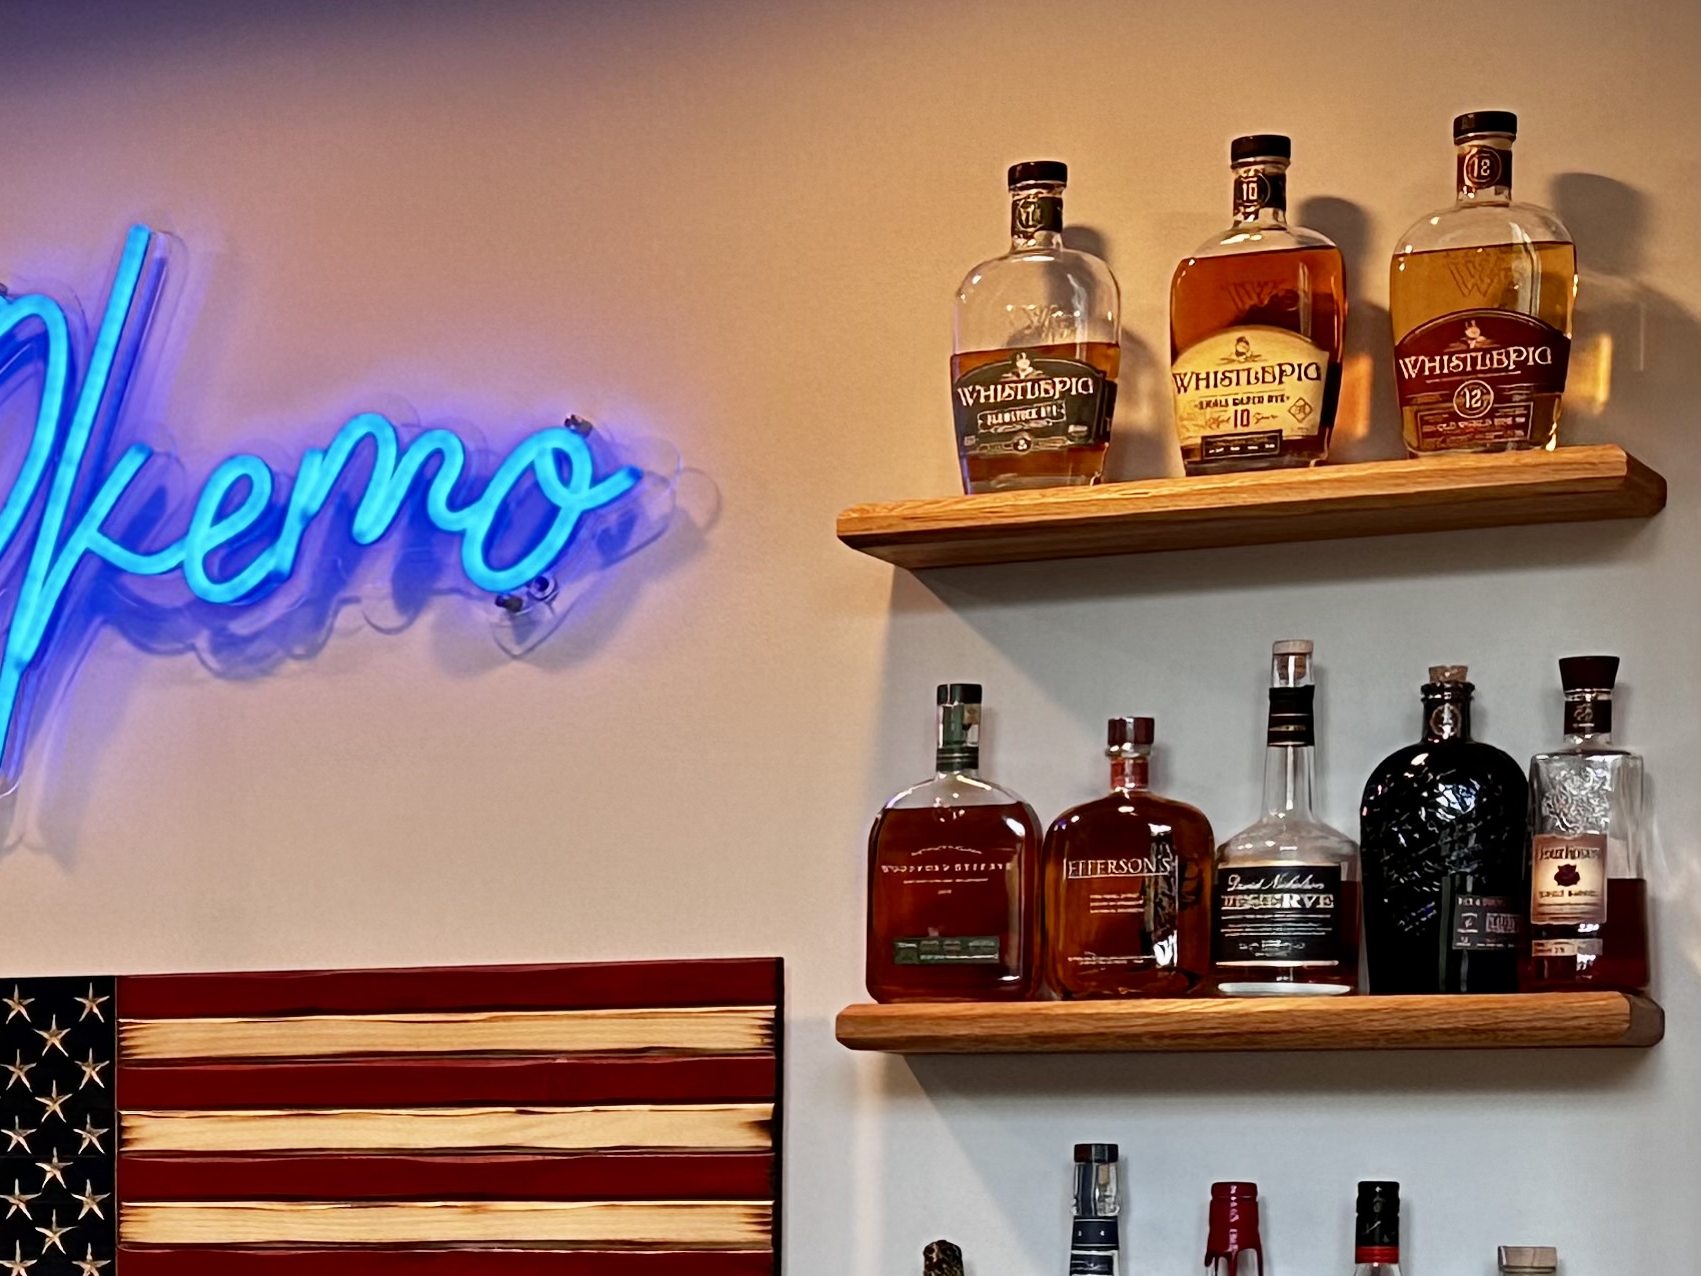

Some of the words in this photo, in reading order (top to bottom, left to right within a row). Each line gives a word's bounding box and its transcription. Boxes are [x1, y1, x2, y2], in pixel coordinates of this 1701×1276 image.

[1172, 362, 1321, 394] WHISTLEPIG
[1464, 387, 1482, 408] 12
[1234, 408, 1250, 429] 10
